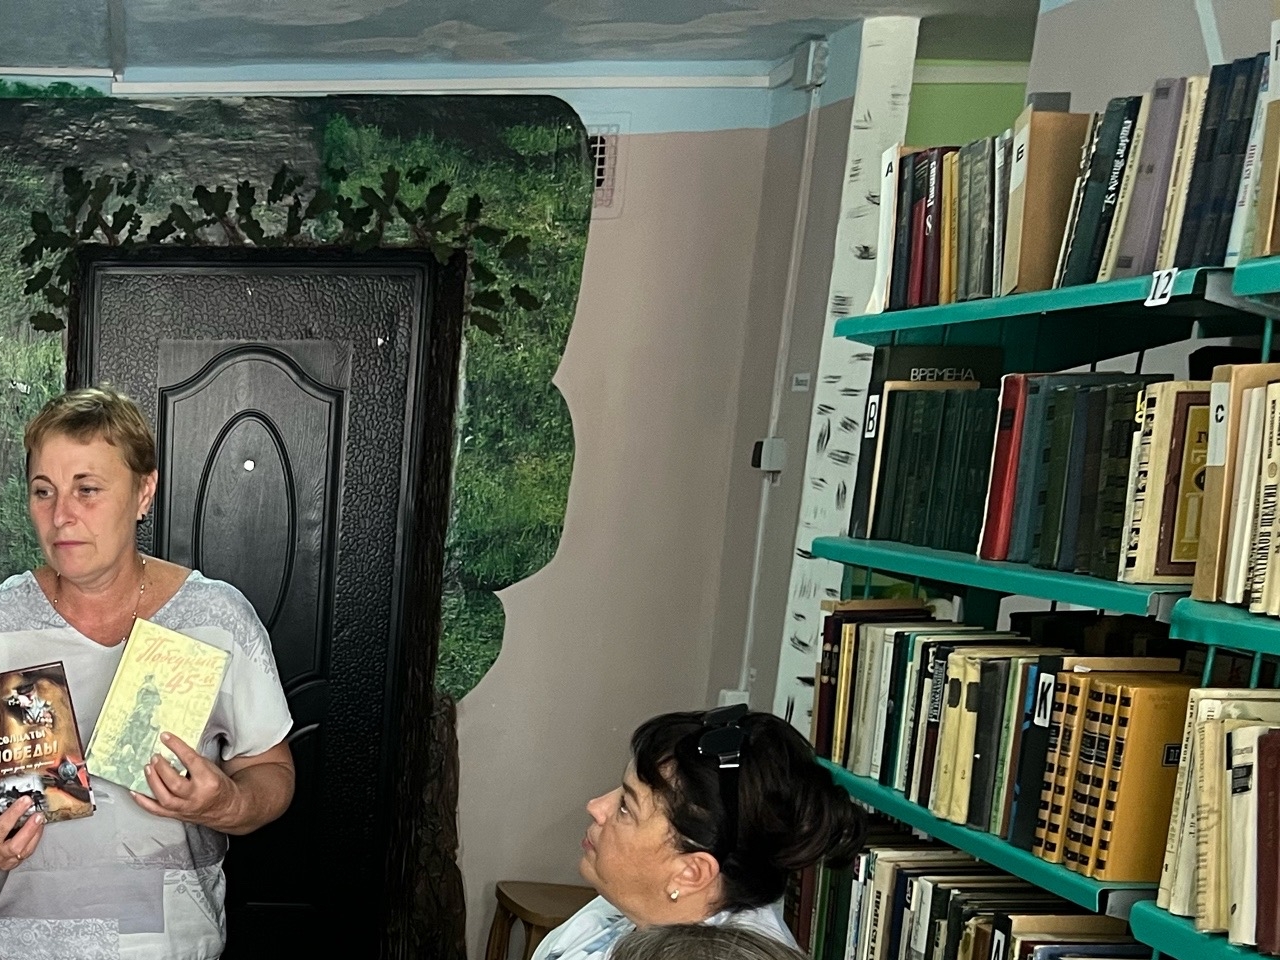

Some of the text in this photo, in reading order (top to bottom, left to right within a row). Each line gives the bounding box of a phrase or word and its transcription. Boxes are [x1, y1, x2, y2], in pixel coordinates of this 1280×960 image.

[885, 161, 893, 177] А
[1151, 272, 1172, 300] 12
[910, 368, 974, 382] ВРЕМЕНА
[1037, 681, 1052, 720] К
